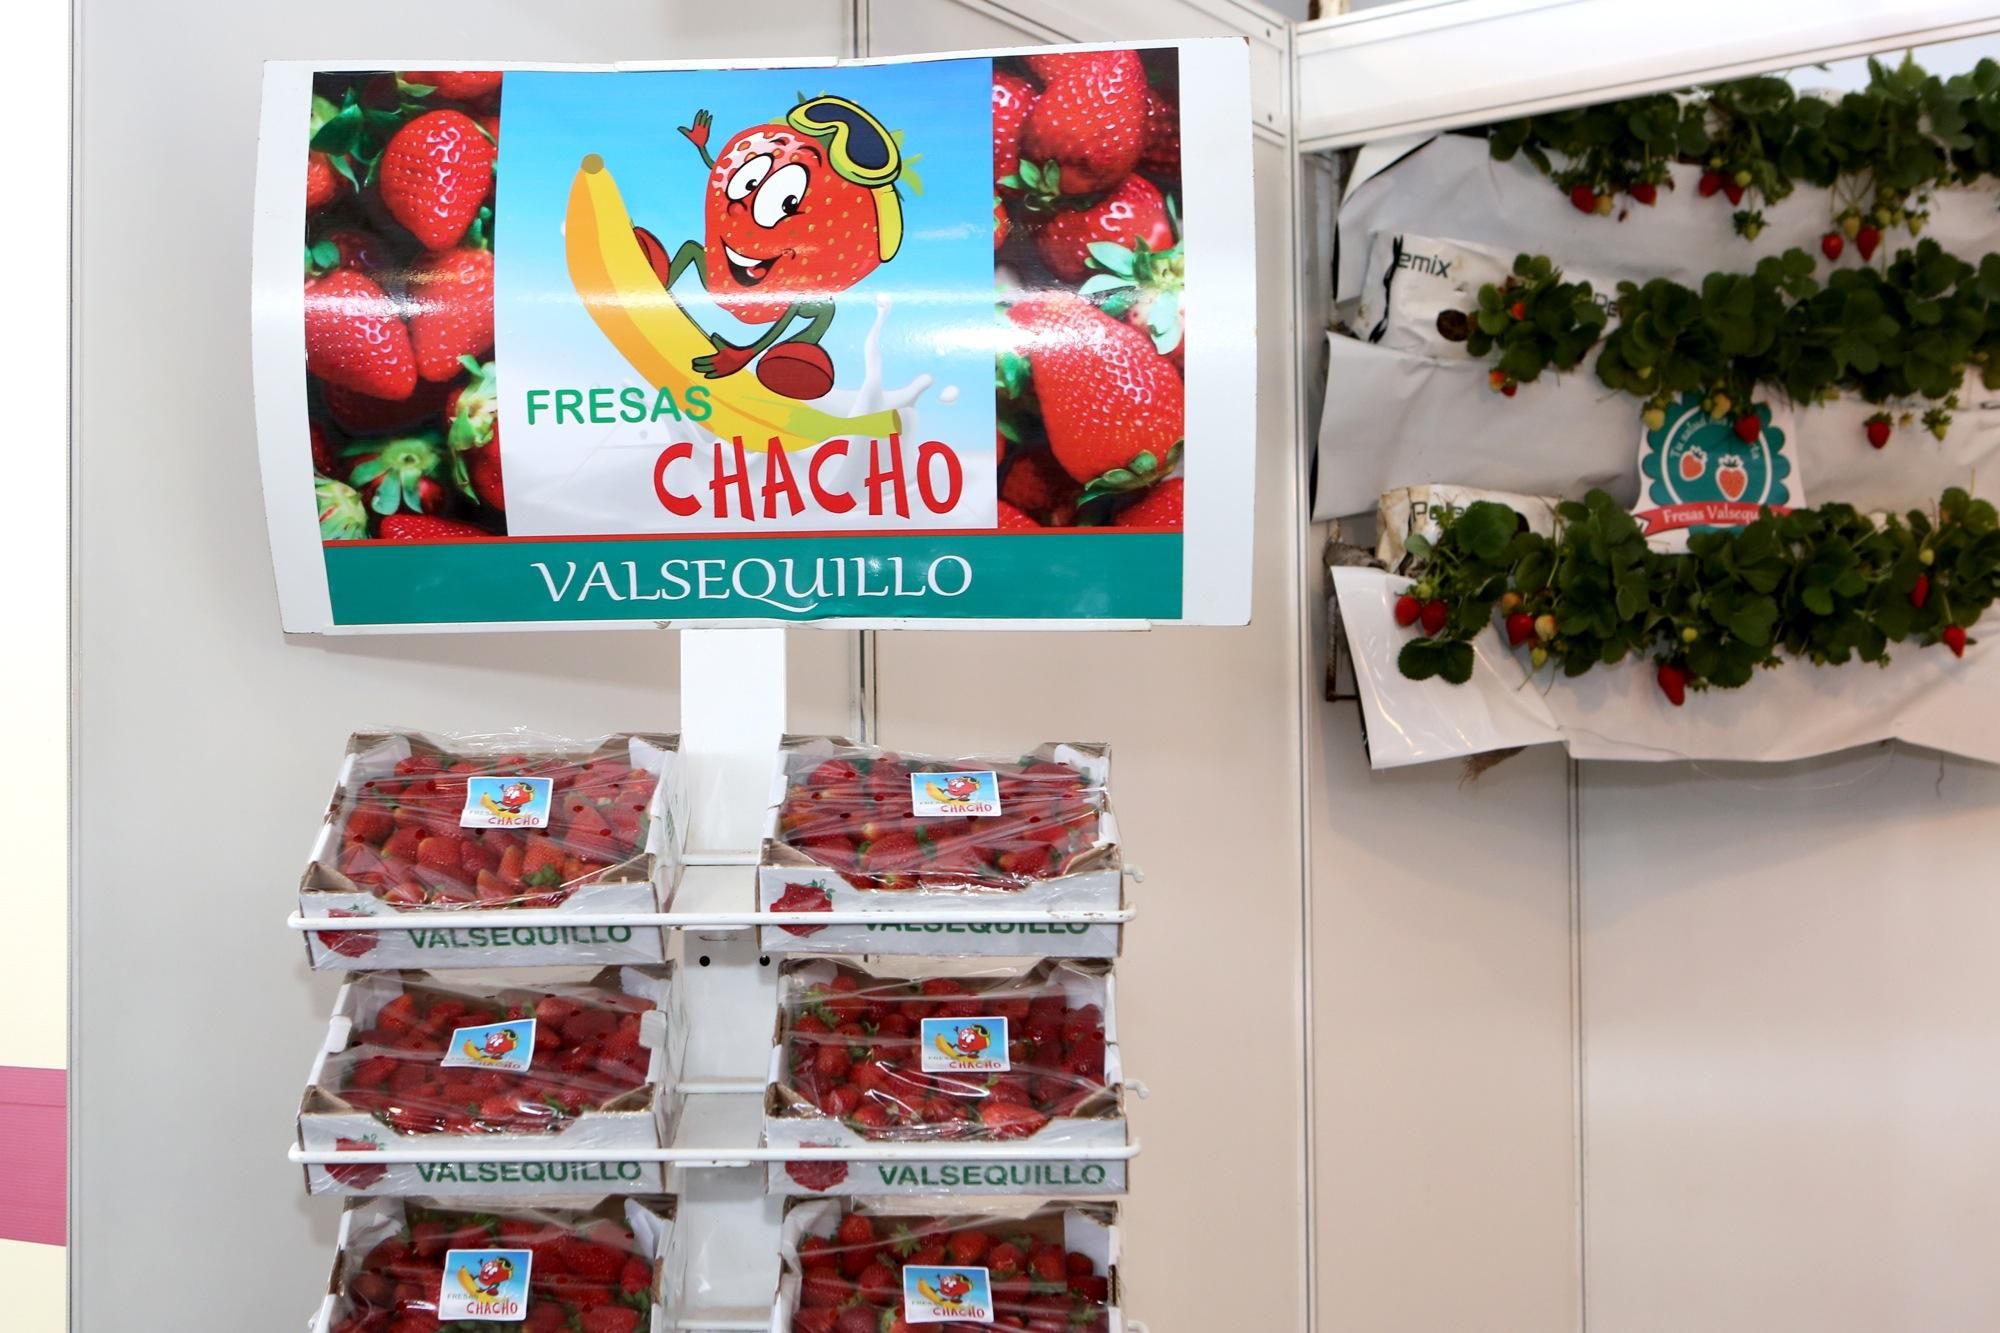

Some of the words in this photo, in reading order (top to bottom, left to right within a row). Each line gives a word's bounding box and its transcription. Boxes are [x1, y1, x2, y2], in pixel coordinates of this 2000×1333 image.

[1593, 292, 1618, 318] Pe
[526, 385, 713, 425] FRESAS
[653, 432, 964, 522] CHACHO
[1663, 509, 1705, 525] Fresas
[1706, 504, 1760, 524] Valsequ
[530, 555, 973, 613] VALSEQUILLO
[940, 802, 993, 813] CHACHO
[488, 816, 540, 826] CHACHO
[408, 925, 632, 949] VALSEQUILLO
[949, 1061, 1002, 1070] CHACHO
[416, 1160, 642, 1183] VALSEQUILLO
[878, 1164, 1106, 1186] VALSEQUILLO
[467, 1299, 518, 1315] CHACHO
[933, 1305, 985, 1318] CHACHO
